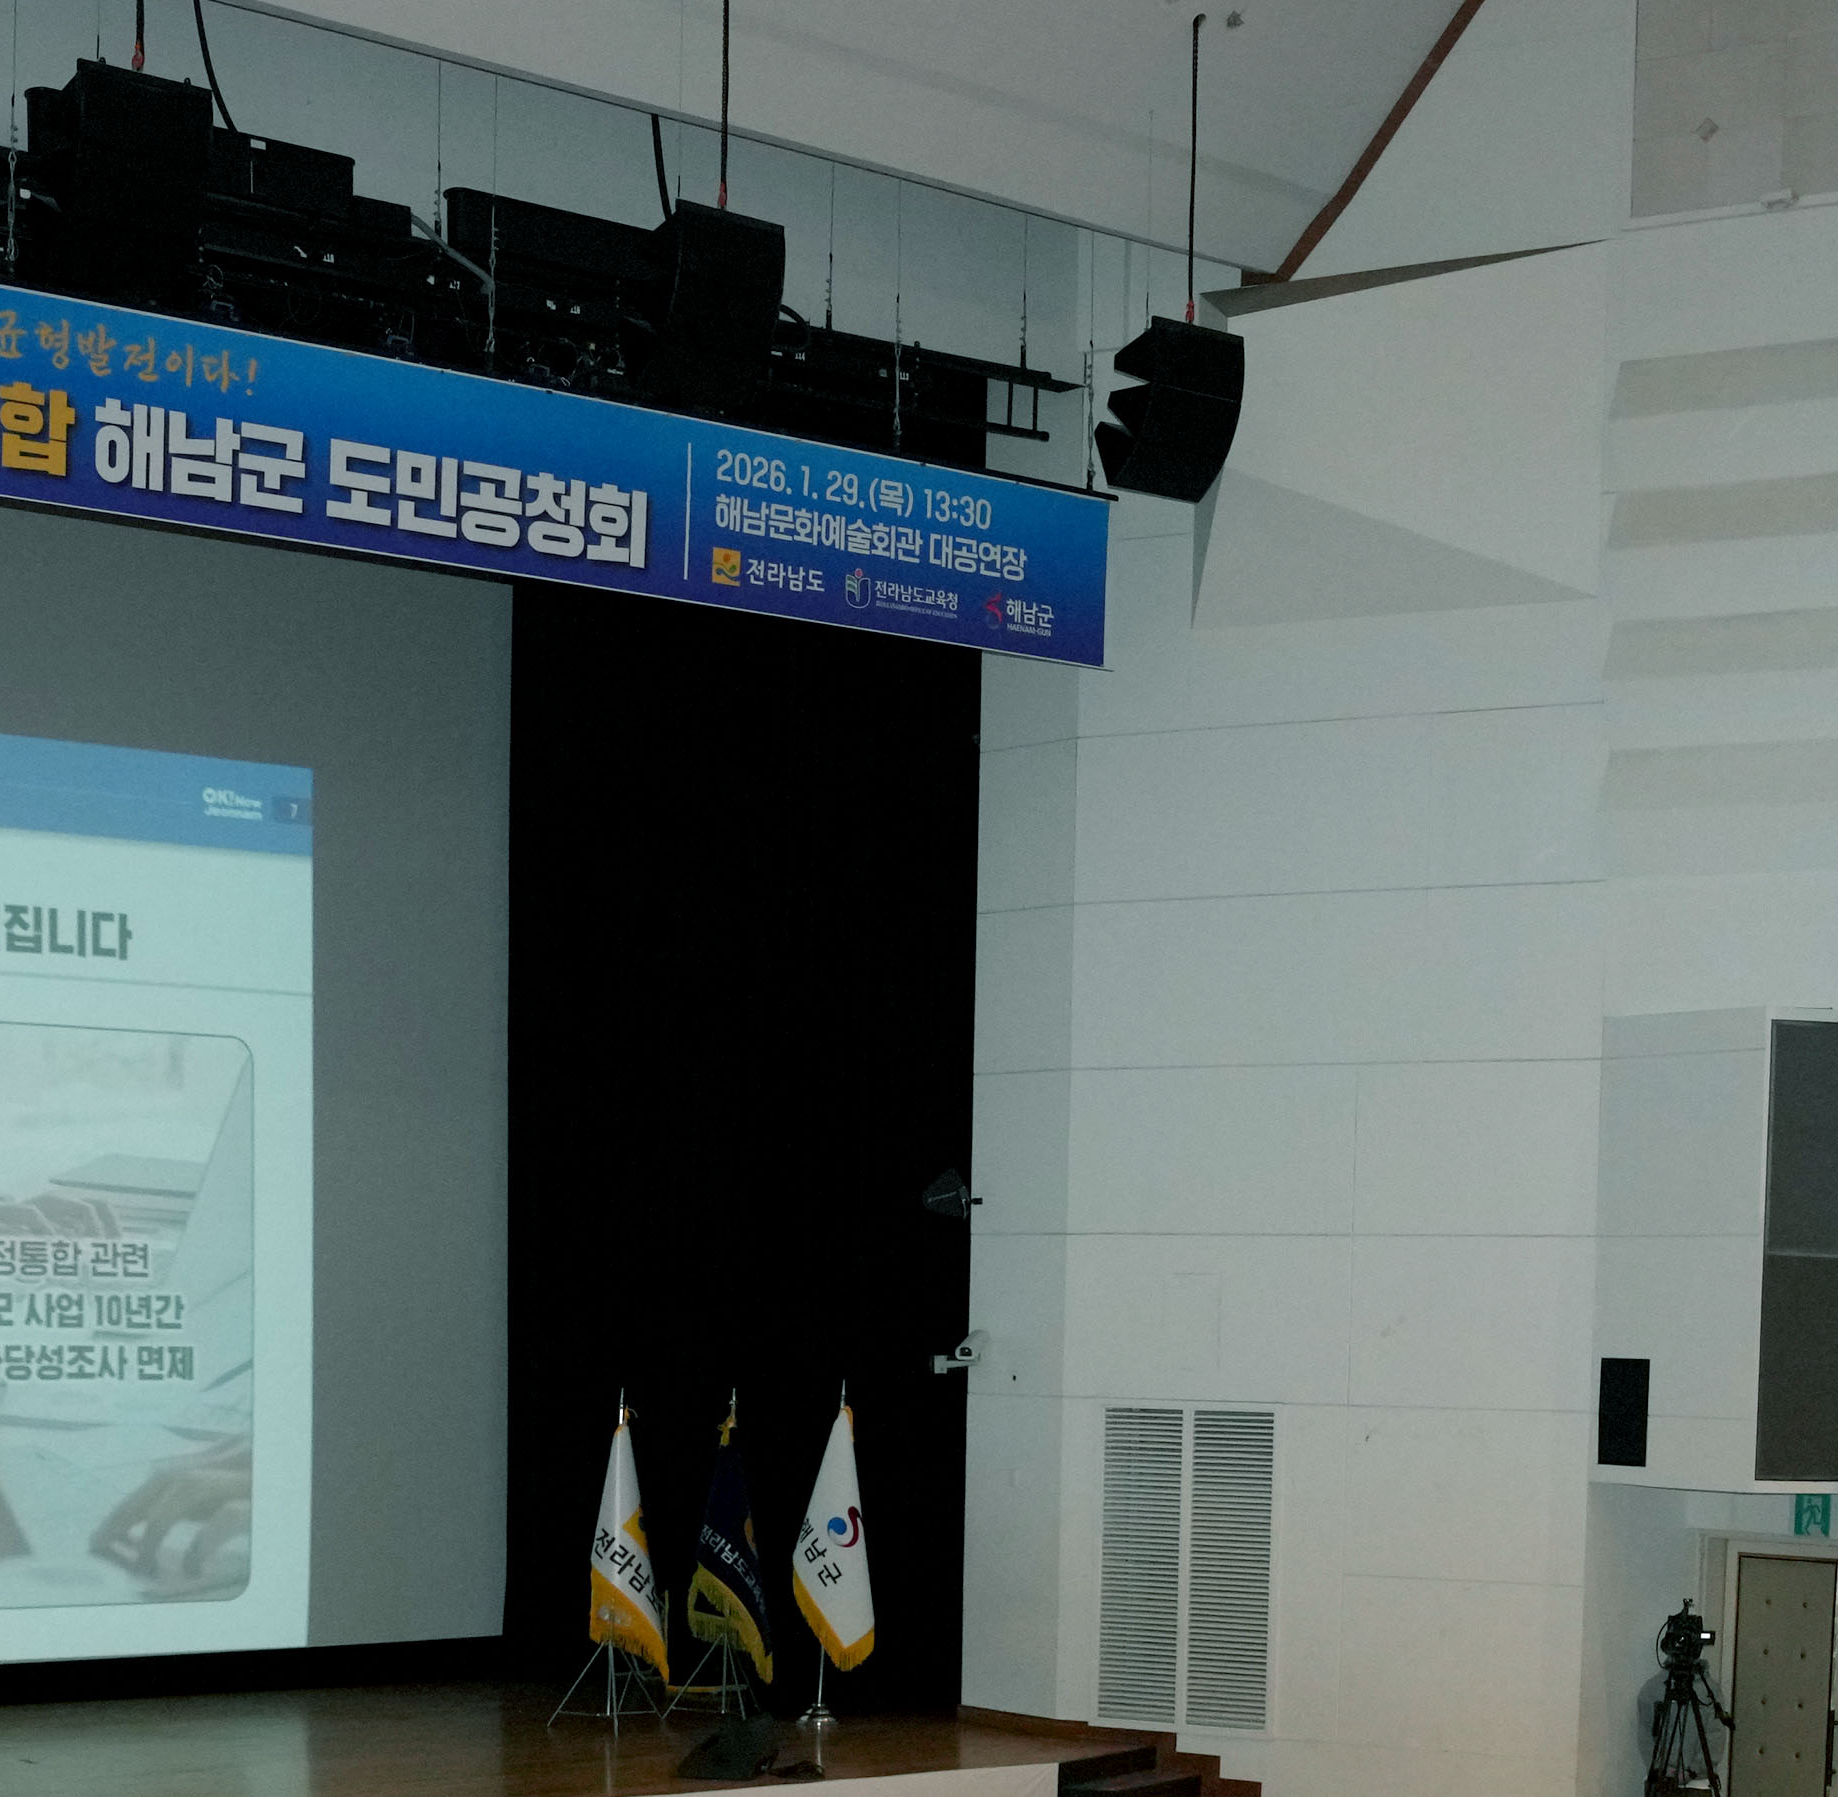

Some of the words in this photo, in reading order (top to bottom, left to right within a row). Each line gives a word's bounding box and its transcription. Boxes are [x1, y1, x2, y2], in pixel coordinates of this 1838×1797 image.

[94, 396, 307, 515] 해남군
[325, 436, 649, 569] 도민공청회
[716, 449, 792, 495] 2026.
[801, 465, 818, 501] 1.
[924, 488, 992, 530] 13:30
[715, 493, 924, 564] 해남문화예술회관
[928, 537, 1028, 582] 대공연장
[746, 559, 826, 593] 전라남도
[875, 580, 959, 612] 전라남도교육청
[1006, 598, 1055, 629] 해남군
[90, 1241, 150, 1278] 관련
[24, 1292, 84, 1328] 사업
[94, 1294, 184, 1330] 10년간
[136, 1344, 195, 1381] 면제
